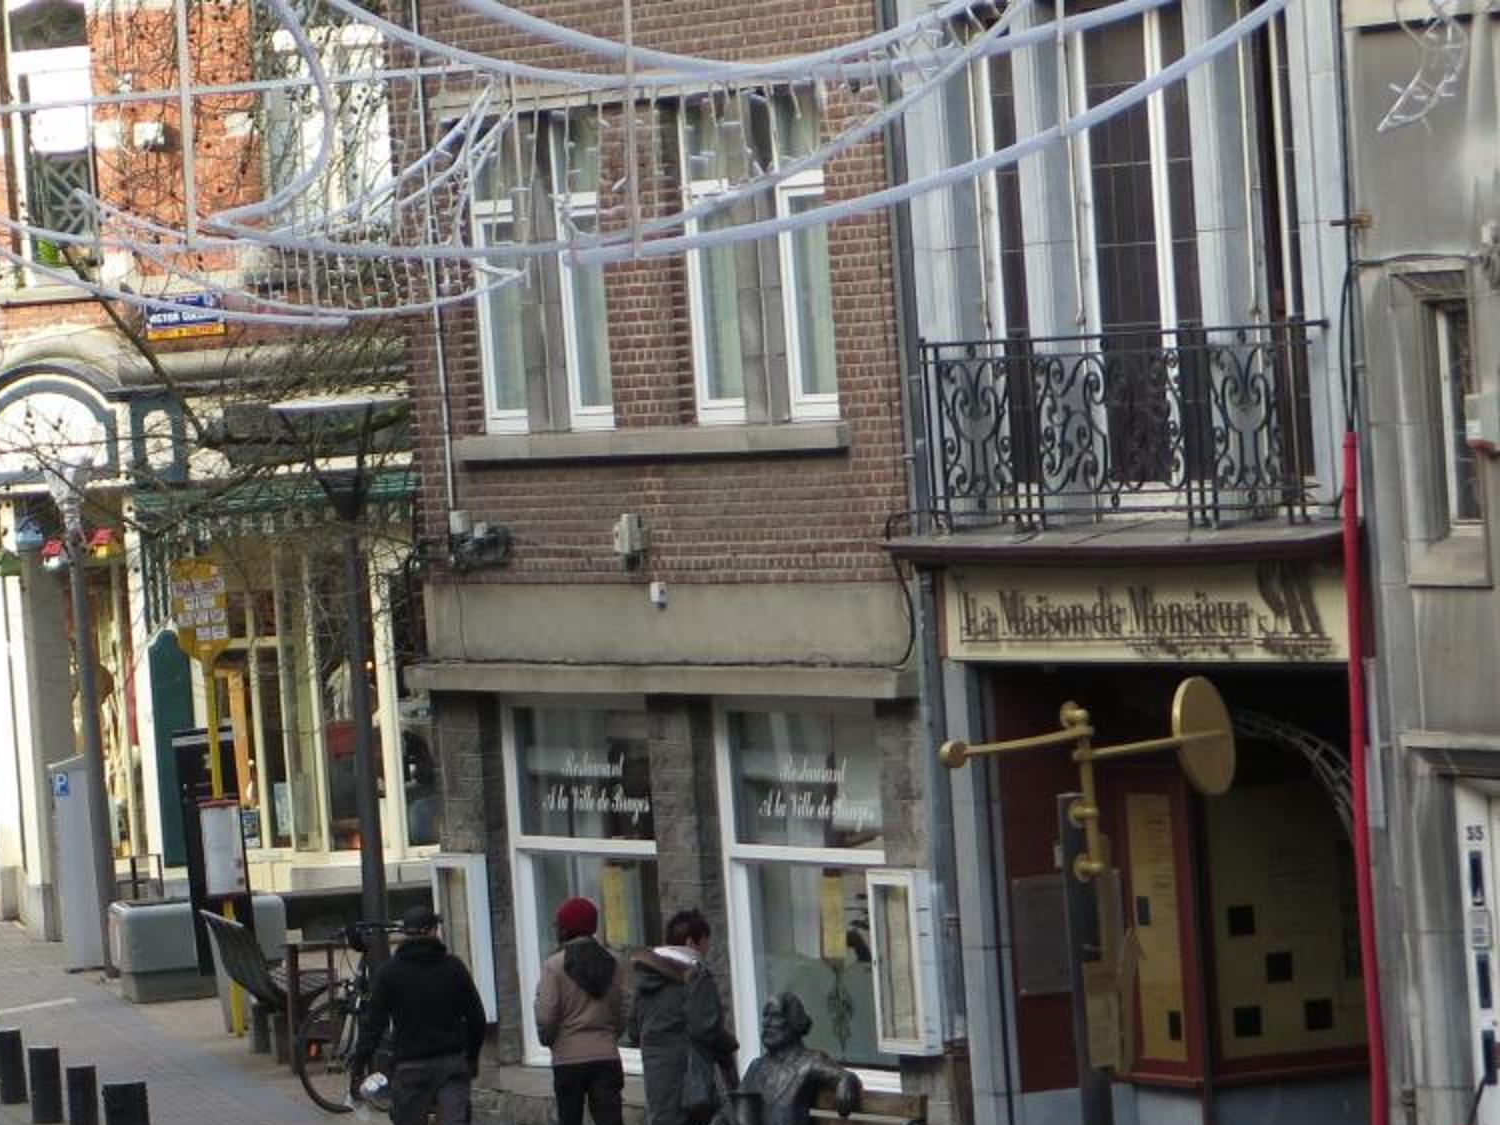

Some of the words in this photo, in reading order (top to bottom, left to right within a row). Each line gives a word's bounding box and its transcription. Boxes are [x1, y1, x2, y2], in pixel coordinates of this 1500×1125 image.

[961, 592, 997, 638] La
[1000, 590, 1087, 636] Maison
[1089, 586, 1125, 636] de
[1128, 585, 1251, 635] Monsieur
[597, 787, 609, 812] de
[817, 795, 830, 818] de
